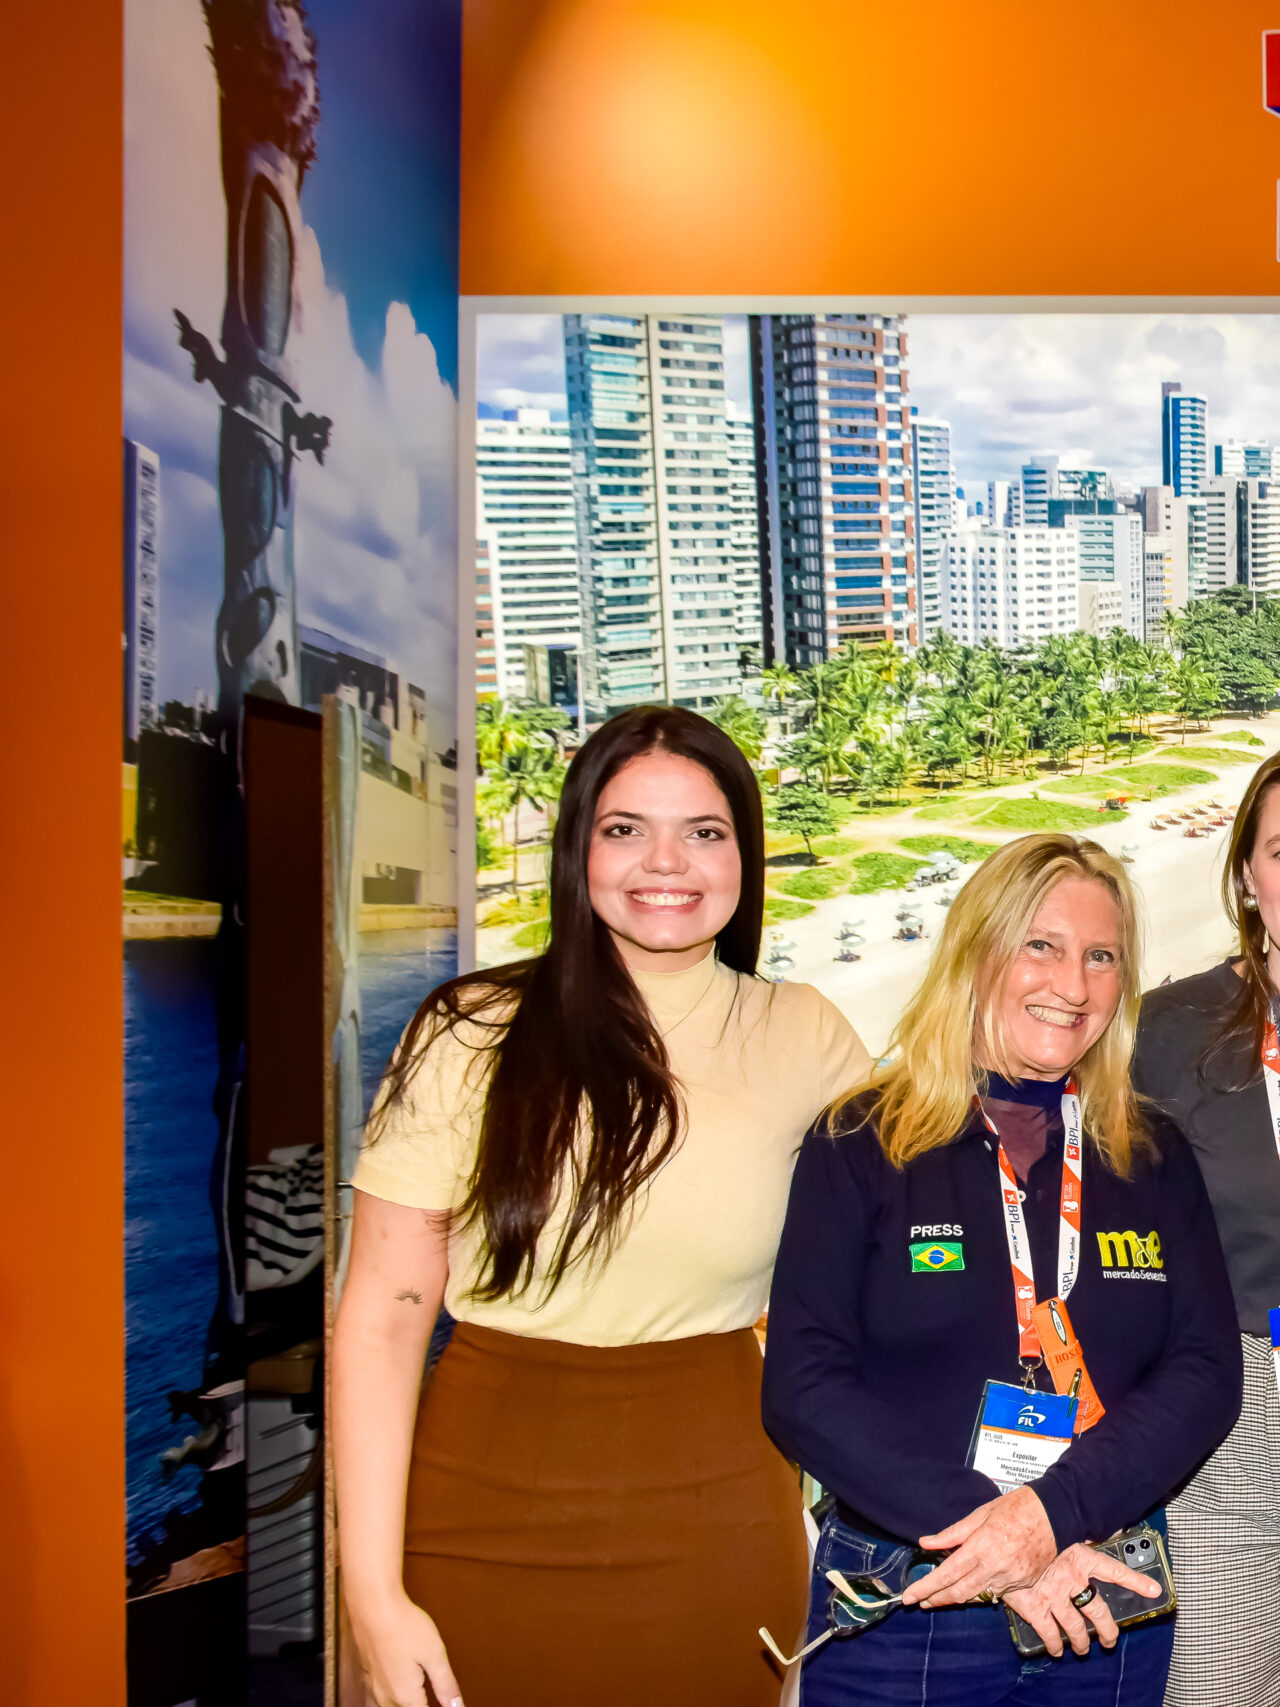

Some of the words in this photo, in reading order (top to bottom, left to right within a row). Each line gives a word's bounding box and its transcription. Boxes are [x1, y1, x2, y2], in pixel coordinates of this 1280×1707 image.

[1069, 1127, 1079, 1146] BPI
[1007, 1205, 1020, 1223] BPI
[910, 1223, 964, 1239] PRESS
[1062, 1271, 1074, 1292] BPI
[1055, 1348, 1080, 1364] ROSA
[1017, 1416, 1034, 1427] FIL
[1012, 1451, 1038, 1461] Expositor
